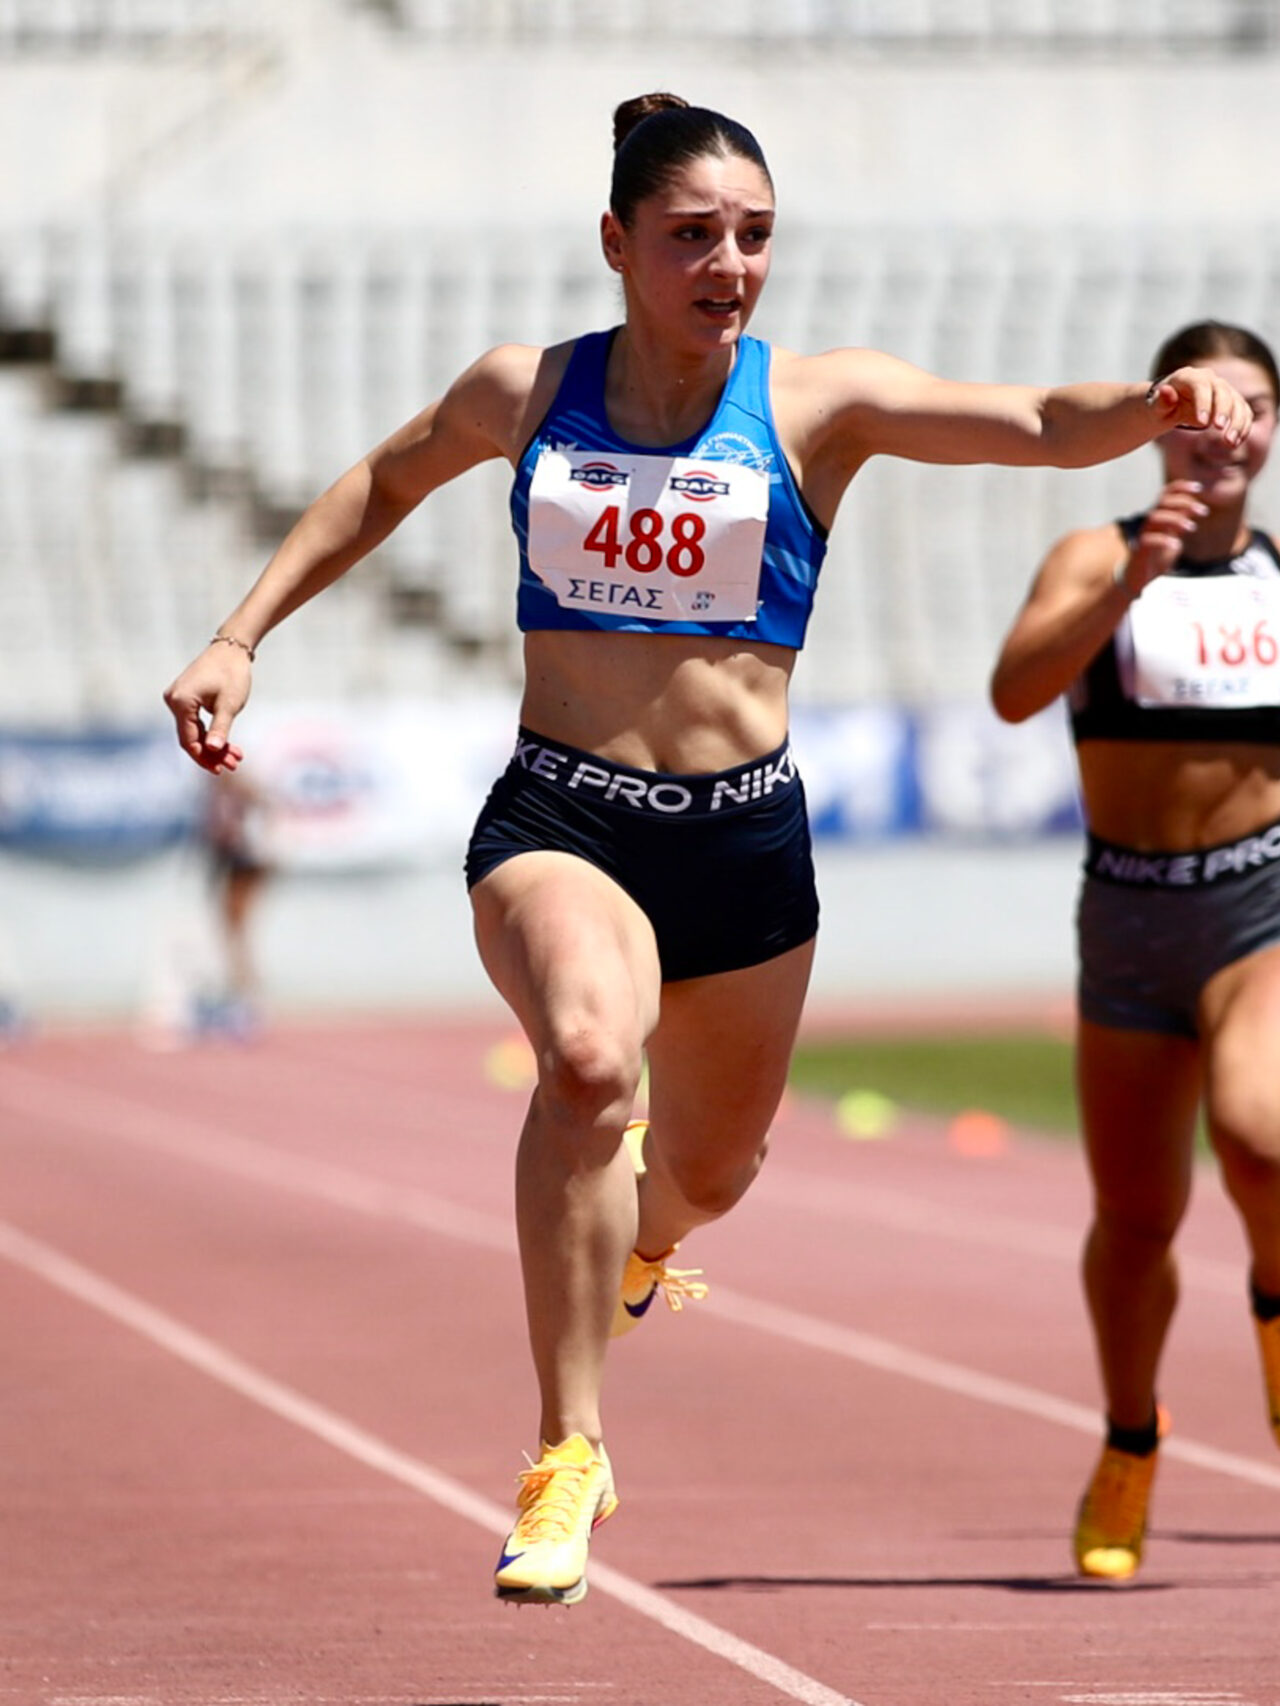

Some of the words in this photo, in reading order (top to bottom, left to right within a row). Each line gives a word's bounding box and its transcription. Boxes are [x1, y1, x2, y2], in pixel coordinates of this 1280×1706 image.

[583, 505, 706, 577] 488
[567, 578, 663, 610] ΣΕΓΑΣ
[1191, 619, 1279, 667] 186
[513, 738, 568, 780] KE
[568, 762, 693, 813] PRO
[1096, 850, 1197, 884] NIKE
